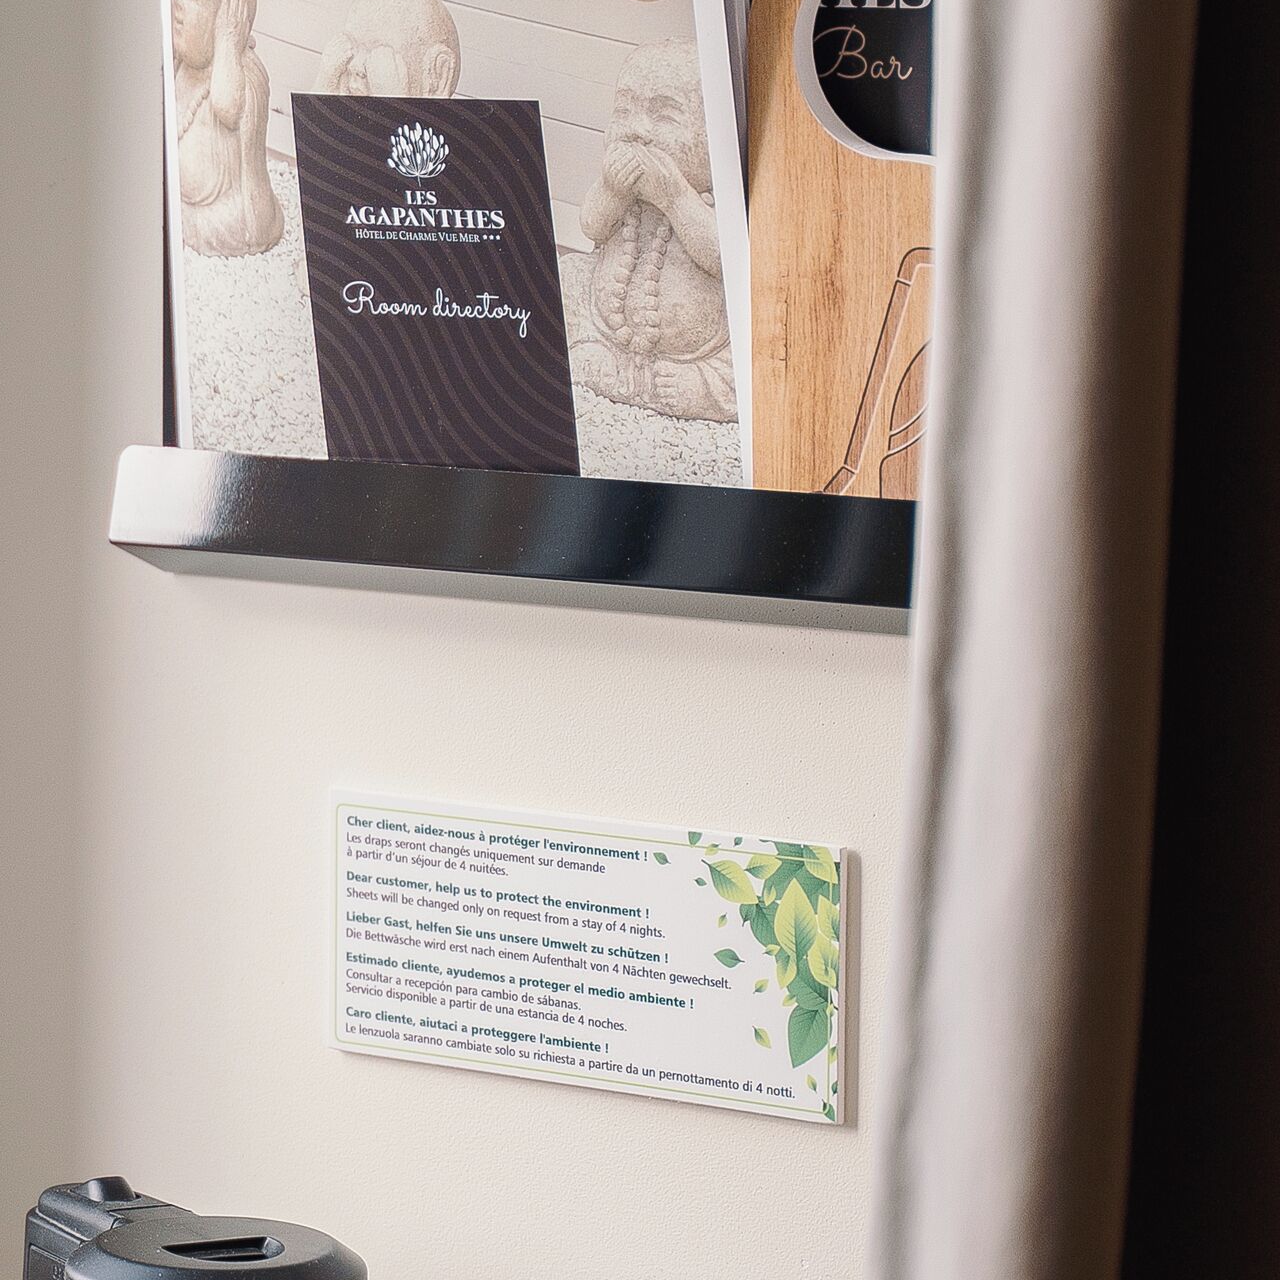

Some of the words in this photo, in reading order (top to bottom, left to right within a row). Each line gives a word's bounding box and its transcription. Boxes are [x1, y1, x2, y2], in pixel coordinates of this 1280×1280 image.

[813, 24, 913, 80] Bar
[345, 206, 506, 230] AGAPANTHES
[405, 190, 438, 205] LES
[355, 228, 386, 240] HÔTEL
[386, 231, 398, 241] DE
[399, 230, 438, 242] CHARME
[439, 232, 459, 243] VUE
[459, 233, 481, 243] MER
[343, 280, 428, 314] Room
[432, 287, 531, 338] directory
[346, 815, 373, 828] Cher
[376, 819, 410, 834] client,
[414, 823, 475, 840] aidez-nous
[478, 830, 485, 842] à
[489, 834, 540, 850] protéger
[346, 831, 361, 843] Les
[364, 833, 392, 849] draps
[395, 840, 426, 851] seront
[429, 842, 470, 858] changés
[473, 848, 535, 865] uniquement
[538, 857, 554, 867] sur
[556, 857, 606, 874] demande
[346, 846, 352, 856] à
[355, 850, 382, 860] partir
[411, 854, 441, 868] séjour
[444, 858, 457, 870] de
[459, 860, 466, 870] 4
[469, 863, 508, 876] nuitées.
[346, 870, 372, 883] Dear
[375, 876, 432, 892] customer,
[435, 880, 460, 897] help
[463, 887, 477, 897] us
[479, 887, 492, 899] to
[496, 891, 539, 905] protect
[541, 894, 562, 908] the
[565, 899, 642, 918] environment
[346, 887, 378, 901] Sheets
[380, 892, 398, 903] will
[401, 893, 414, 906] be
[416, 895, 459, 912] changed
[462, 902, 484, 917] only
[486, 907, 500, 917] on
[503, 909, 541, 922] request
[544, 911, 569, 926] from
[572, 918, 578, 927] a
[581, 918, 603, 933] stay
[605, 920, 617, 931] of
[619, 922, 626, 933] 4
[629, 923, 665, 939] nights.
[346, 911, 381, 925] Lieber
[383, 916, 412, 931] Gast,
[416, 919, 452, 935] helfen
[455, 925, 472, 937] Sie
[475, 930, 496, 940] uns
[499, 933, 538, 946] unsere
[541, 936, 587, 953] Umwelt
[590, 945, 604, 955] zu
[607, 945, 660, 963] schützen
[346, 927, 362, 939] Die
[364, 930, 421, 947] Bettwäsche
[423, 938, 446, 951] wird
[449, 943, 468, 954] erst
[471, 945, 495, 957] nach
[498, 947, 529, 962] einem
[532, 952, 587, 970] Aufenthalt
[589, 962, 609, 973] von
[612, 963, 619, 974] 4
[622, 964, 666, 980] Nächten
[669, 973, 731, 990] gewechselt.
[345, 968, 393, 983] Consultar
[395, 977, 401, 985] a
[404, 978, 452, 992] recepción
[455, 985, 478, 996] para
[480, 988, 518, 1002] cambio
[521, 991, 534, 1004] de
[536, 994, 581, 1011] sábanas.
[346, 951, 398, 968] Estimado
[401, 959, 443, 976] cliente,
[446, 967, 505, 983] ayudemos
[508, 975, 515, 984] a
[519, 977, 571, 993] proteger
[573, 982, 584, 994] el
[587, 986, 625, 999] medio
[628, 991, 686, 1008] ambiente
[345, 982, 383, 997] Servicio
[385, 987, 437, 1005] disponible
[439, 997, 446, 1006] a
[449, 998, 477, 1010] partir
[479, 1000, 492, 1012] de
[495, 1005, 514, 1015] una
[517, 1008, 559, 1022] estancia
[561, 1012, 575, 1024] de
[577, 1014, 584, 1025] 4
[587, 1017, 627, 1032] noches.
[345, 1006, 371, 1019] Caro
[374, 1010, 416, 1027] cliente,
[419, 1016, 457, 1031] aiutaci
[460, 1024, 468, 1033] a
[471, 1026, 536, 1043] proteggere
[345, 1022, 356, 1033] Le
[359, 1023, 400, 1040] lenzuola
[403, 1033, 443, 1046] saranno
[445, 1039, 492, 1053] cambiate
[494, 1044, 516, 1057] solo
[518, 1050, 530, 1059] su
[533, 1049, 576, 1066] richiesta
[578, 1058, 585, 1067] a
[588, 1059, 623, 1073] partire
[625, 1062, 639, 1075] da
[641, 1067, 655, 1077] un
[658, 1070, 739, 1090] pernottamento
[742, 1080, 753, 1092] di
[755, 1082, 763, 1093] 4
[766, 1086, 795, 1099] notti.
